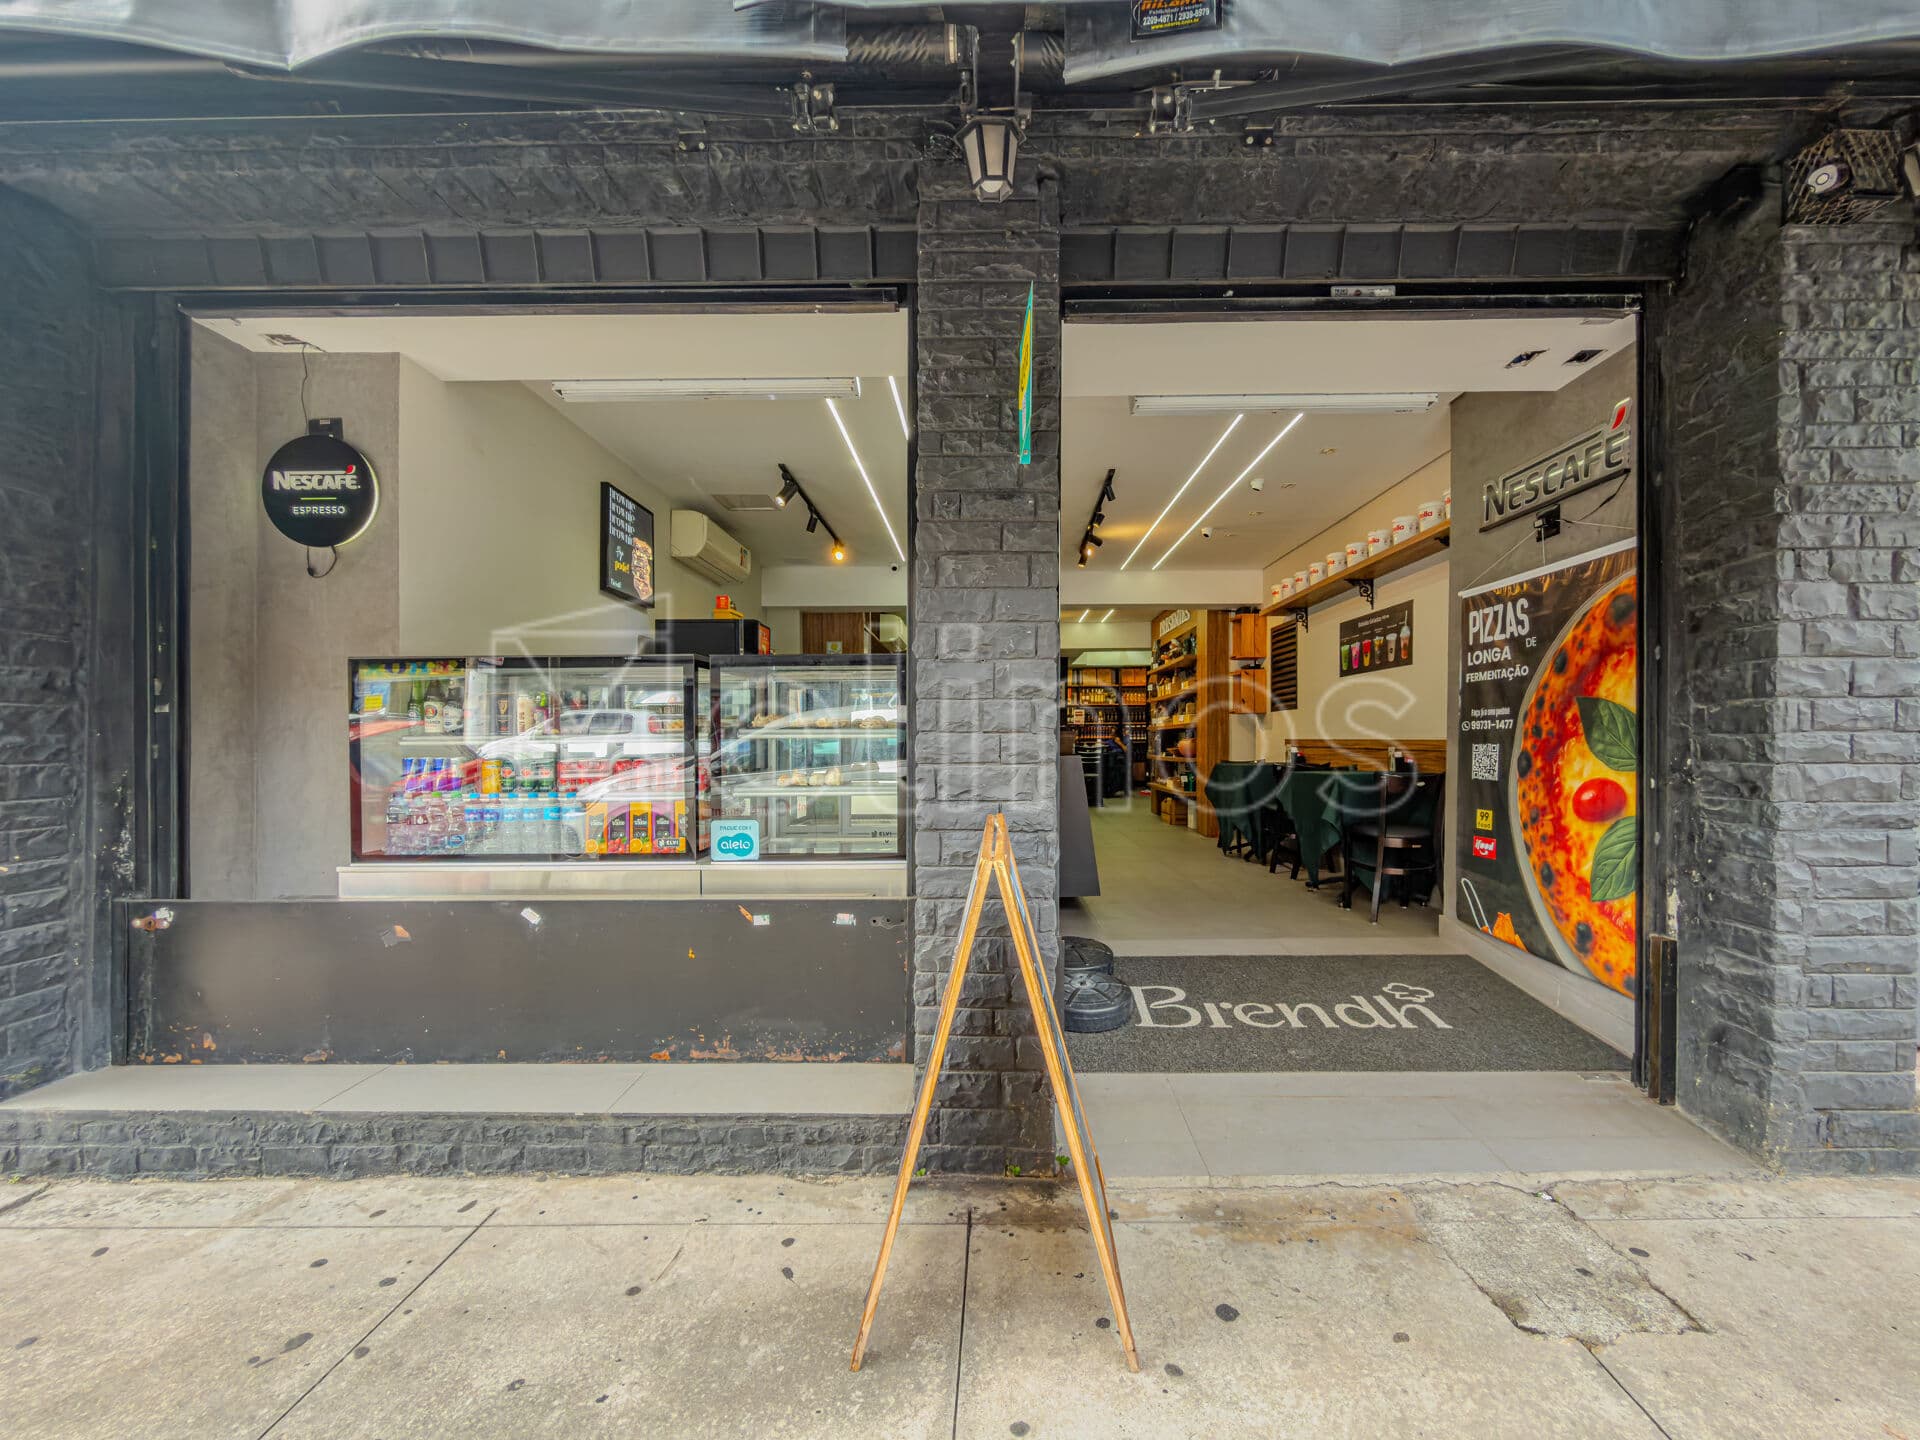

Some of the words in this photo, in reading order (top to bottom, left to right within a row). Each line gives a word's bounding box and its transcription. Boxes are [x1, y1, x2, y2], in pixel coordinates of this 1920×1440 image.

[1484, 404, 1627, 521] NESCAFÉ
[272, 465, 360, 490] NESCAFÉ
[293, 506, 346, 515] ESPRESSO
[1468, 597, 1530, 646] PIZZAS
[1525, 636, 1537, 648] DE
[1467, 645, 1512, 667] LONGA
[1465, 663, 1530, 683] FERMENTAÇÃO
[1471, 719, 1514, 730] 99731-1477
[1479, 811, 1490, 821] 99
[720, 839, 751, 849] alelo
